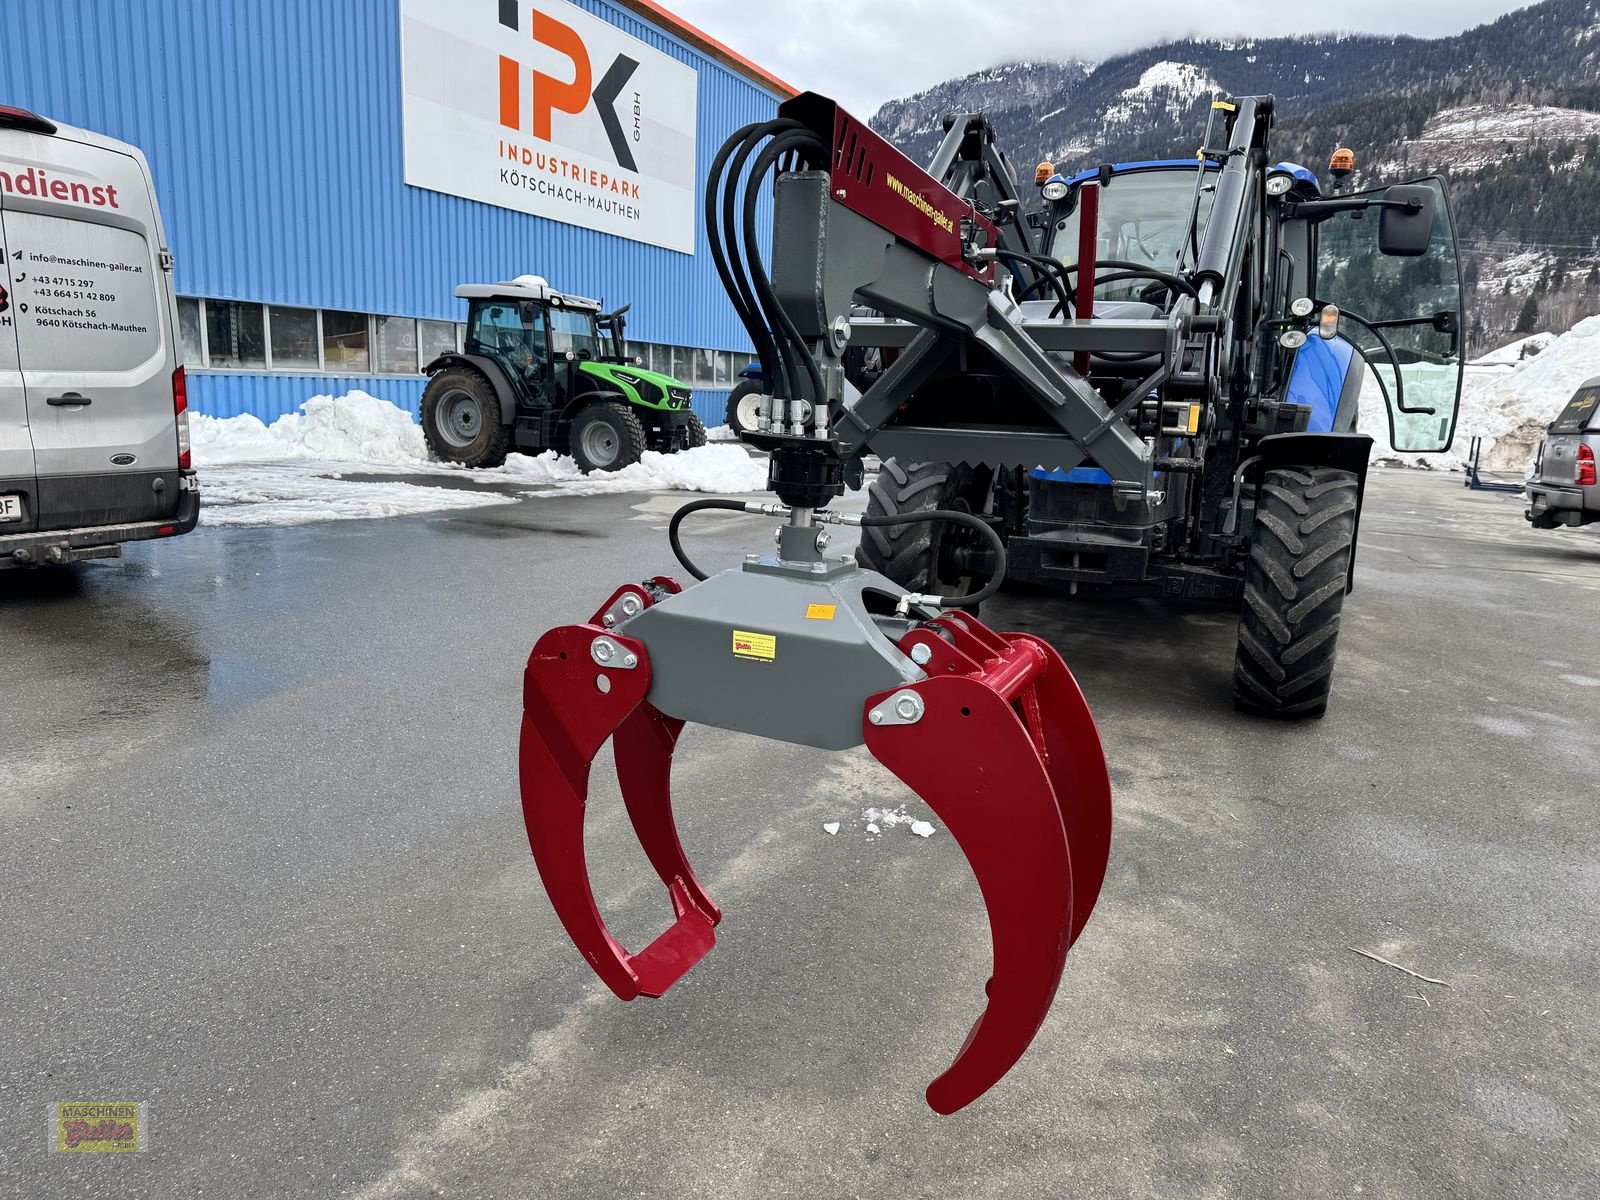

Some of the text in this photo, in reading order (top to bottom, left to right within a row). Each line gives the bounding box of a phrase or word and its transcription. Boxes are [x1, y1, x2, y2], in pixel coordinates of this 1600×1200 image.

[633, 92, 641, 142] GMBH
[500, 140, 640, 200] INDUSTRIEPARK
[500, 168, 640, 221] KÖTSCHACH-MAUTHEN
[886, 172, 954, 234] www.maschinen-gailer.at
[29, 253, 143, 273] info@maschinen-gailer.at
[32, 276, 94, 288] +43 4715 297
[33, 288, 116, 302] +43 664 51 42 809
[35, 305, 97, 318] Kötschach 56
[36, 318, 147, 333] 9640 Kötschach-Mauthen
